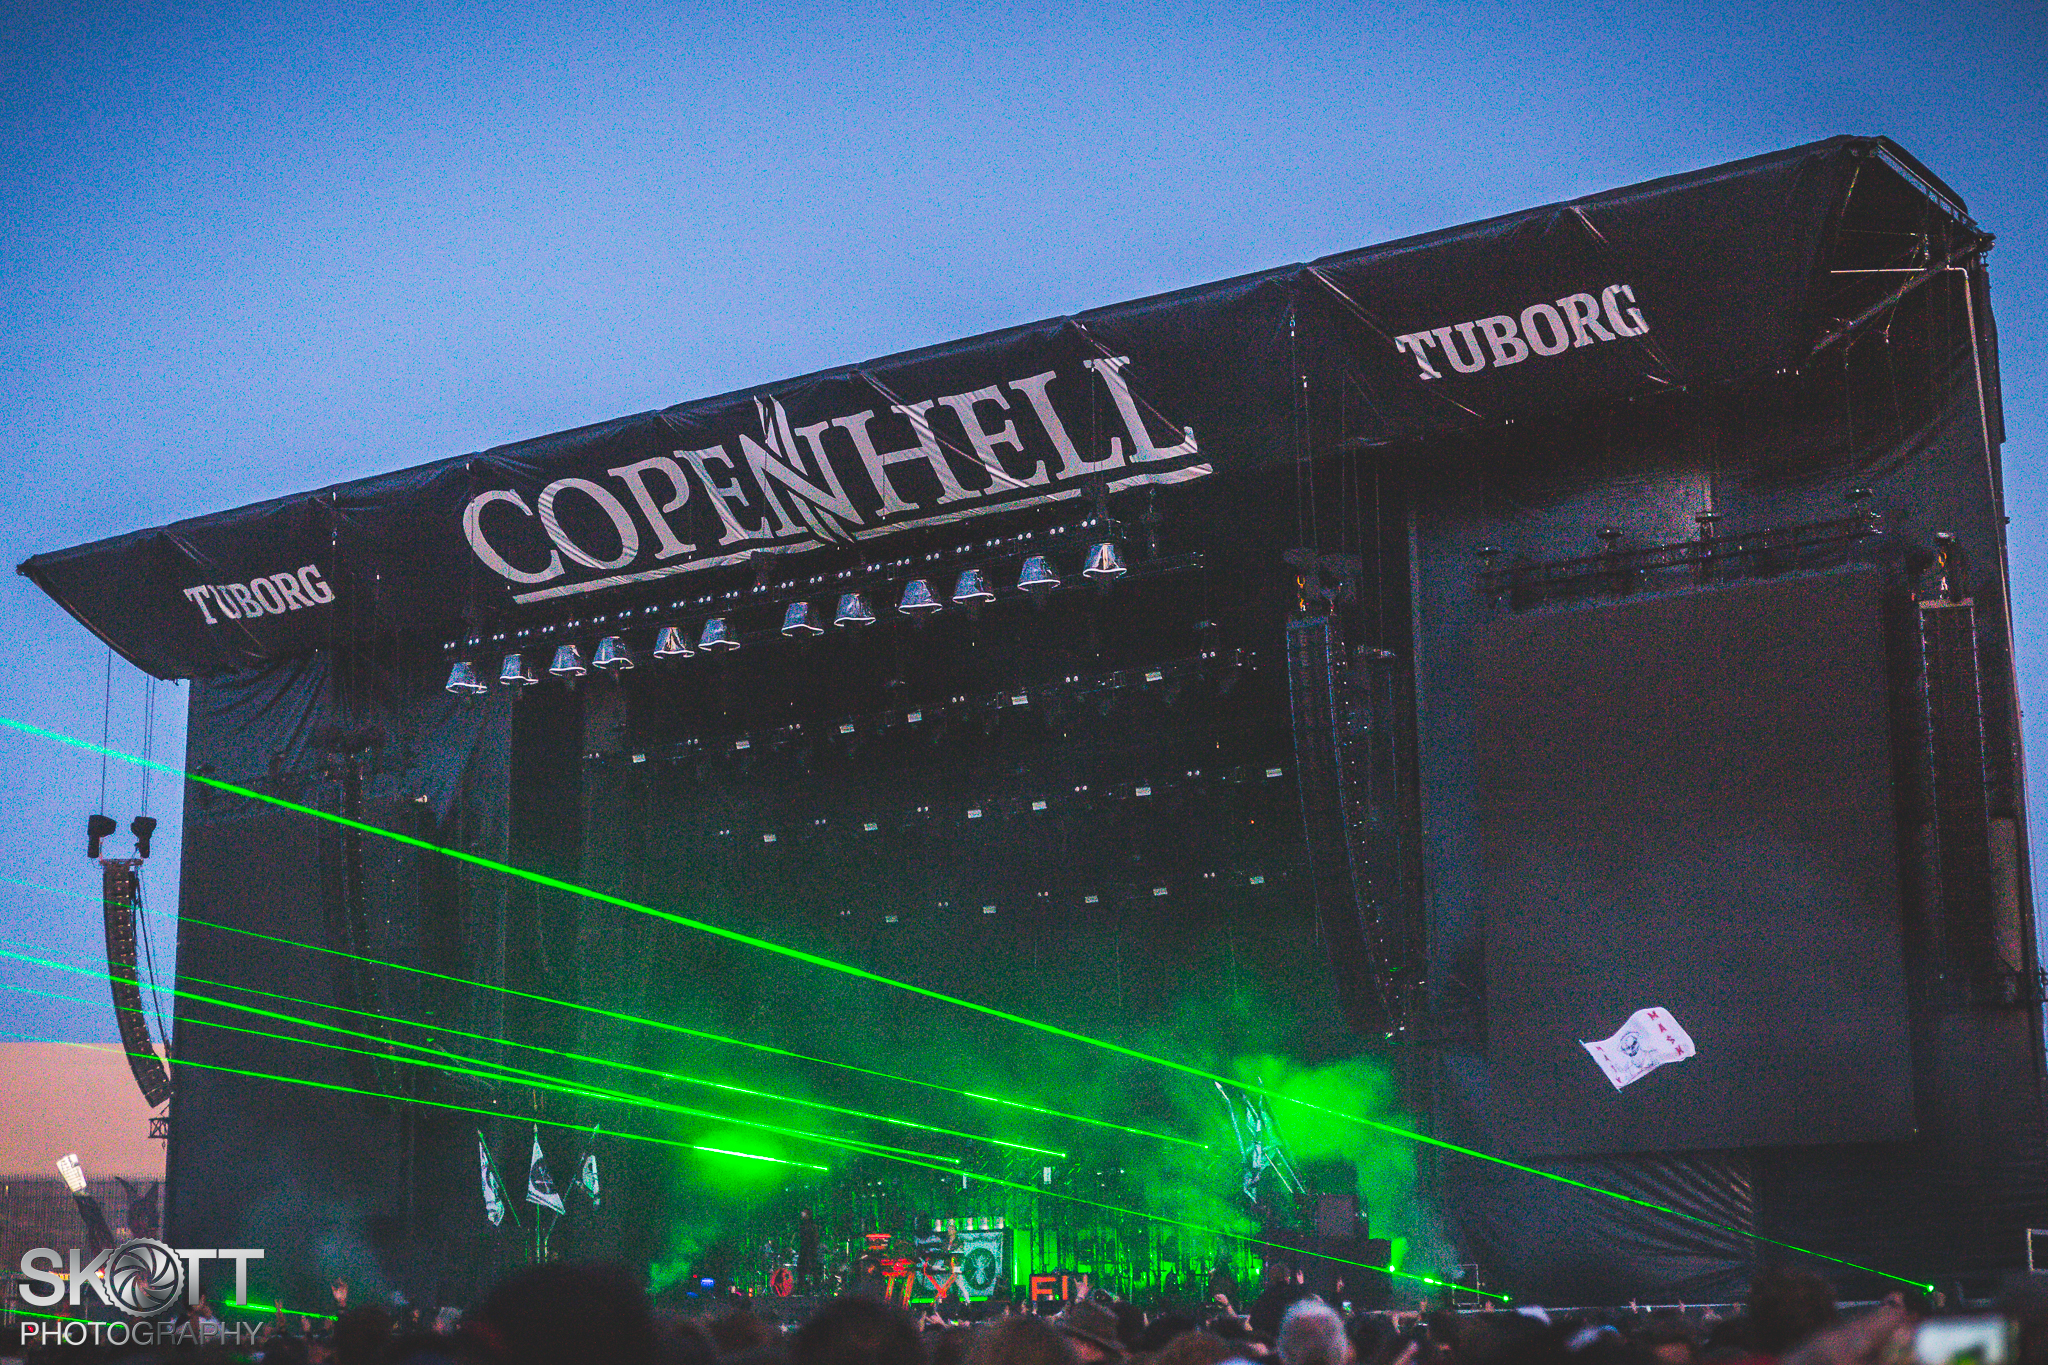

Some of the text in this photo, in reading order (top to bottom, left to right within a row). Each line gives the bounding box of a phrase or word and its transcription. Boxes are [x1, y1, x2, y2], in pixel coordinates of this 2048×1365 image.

[1394, 284, 1650, 380] TUBORG
[462, 355, 1198, 585] COPENHELL
[176, 564, 336, 625] TUBORG
